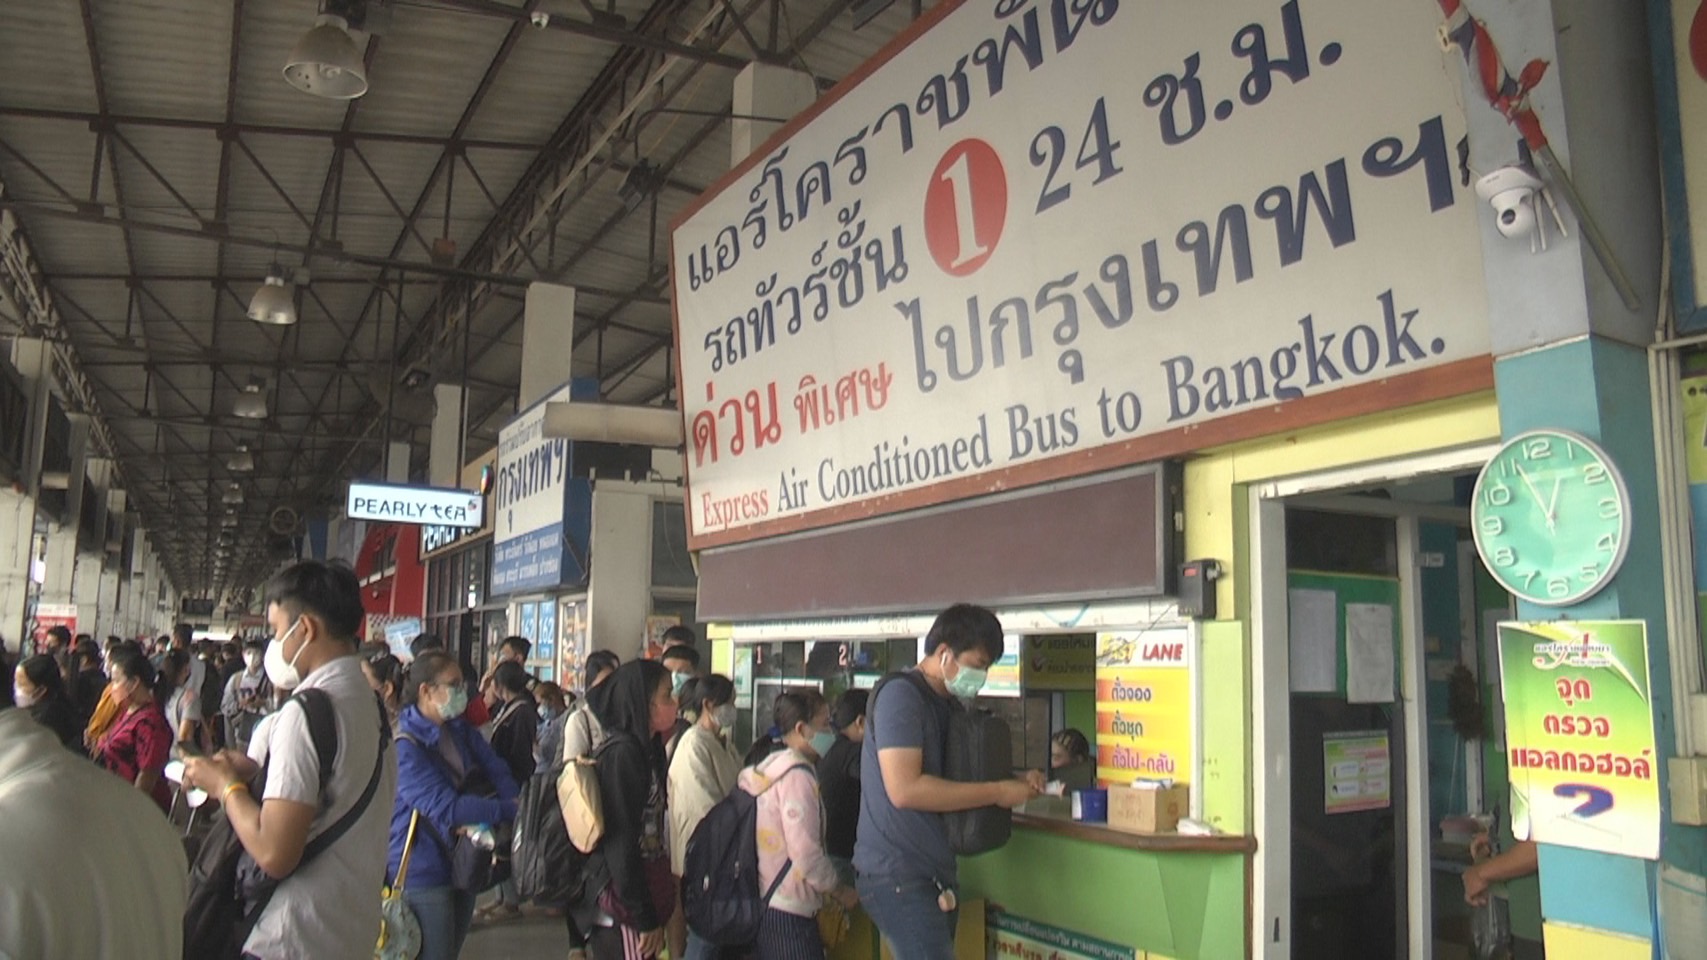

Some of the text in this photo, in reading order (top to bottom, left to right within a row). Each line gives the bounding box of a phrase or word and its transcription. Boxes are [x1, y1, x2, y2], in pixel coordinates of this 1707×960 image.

[704, 0, 1342, 373] รถทัวร์ชั้น 1 24 ช.ม.
[691, 115, 1454, 468] ด่วน พิเศษ ไปกรุงเทพฯ
[702, 288, 1446, 531] Express Air Conditioned Bus to Bangkok.
[1522, 438, 1551, 460] 12
[1566, 441, 1574, 460] 1
[1500, 459, 1518, 477] 11
[1583, 463, 1606, 485] 2
[1484, 482, 1511, 507] 10
[353, 497, 427, 518] PEARLY
[1598, 497, 1621, 520] 3
[1481, 515, 1503, 537] 9
[1597, 533, 1617, 554] 4
[1494, 547, 1516, 568] 8
[1515, 570, 1541, 591] 7
[1578, 562, 1601, 583] 5
[1546, 577, 1570, 598] 6
[838, 644, 847, 666] 2
[1142, 643, 1184, 661] LANE
[1555, 678, 1592, 706] จุด
[1543, 714, 1611, 738] ตรวจ
[1510, 748, 1652, 780] แอลกอฮอล์
